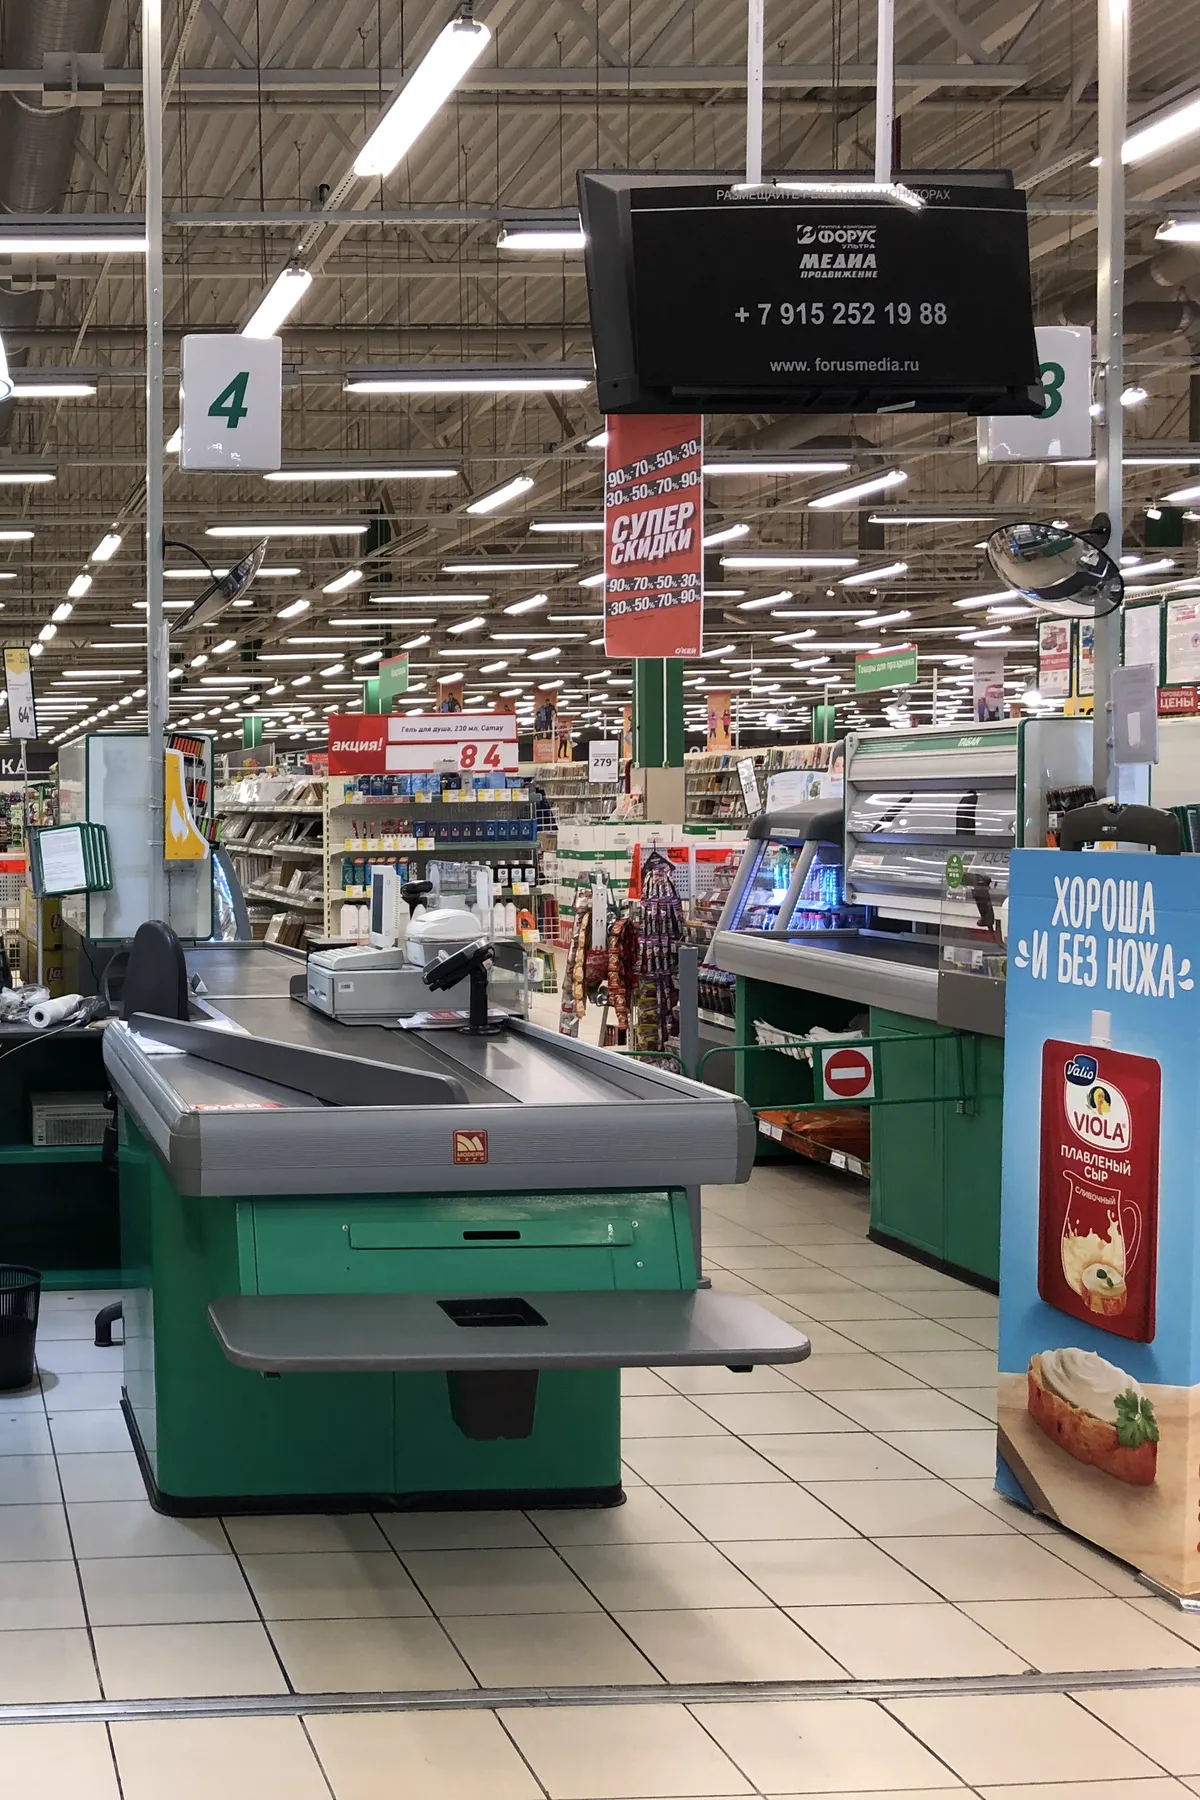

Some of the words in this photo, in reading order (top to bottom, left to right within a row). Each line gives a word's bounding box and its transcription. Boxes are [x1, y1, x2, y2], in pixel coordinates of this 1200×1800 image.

[880, 188, 951, 200] ОНИТОРАХ
[818, 230, 877, 243] ФОРУС
[799, 253, 877, 269] МЕДИА
[800, 270, 879, 279] ПРОДВИЖЕНИЕ
[758, 304, 771, 326] 7
[780, 304, 824, 326] 915
[832, 303, 875, 325] 252
[884, 303, 912, 325] 19
[919, 303, 948, 325] 88
[770, 360, 811, 373] www.
[815, 357, 920, 373] forusmedia.ru
[208, 372, 250, 428] 4
[612, 502, 695, 543] СУПЕР
[610, 528, 692, 565] СКИДКИ
[1160, 697, 1194, 708] ЦЕНЫ
[332, 738, 384, 752] акция!
[593, 758, 611, 767] 279
[1052, 875, 1155, 936] ХОРОША
[1031, 929, 1048, 980] И
[1058, 932, 1097, 988] БЕЗ
[1106, 938, 1175, 999] НОЖА
[1066, 1064, 1094, 1080] Valio
[1073, 1111, 1125, 1143] VIOLA
[1060, 1145, 1131, 1176] ПЛАВЛЕНЫЙ
[1084, 1166, 1108, 1182] СЫР
[1075, 1186, 1116, 1205] СЛИВОЧНЫЙ
